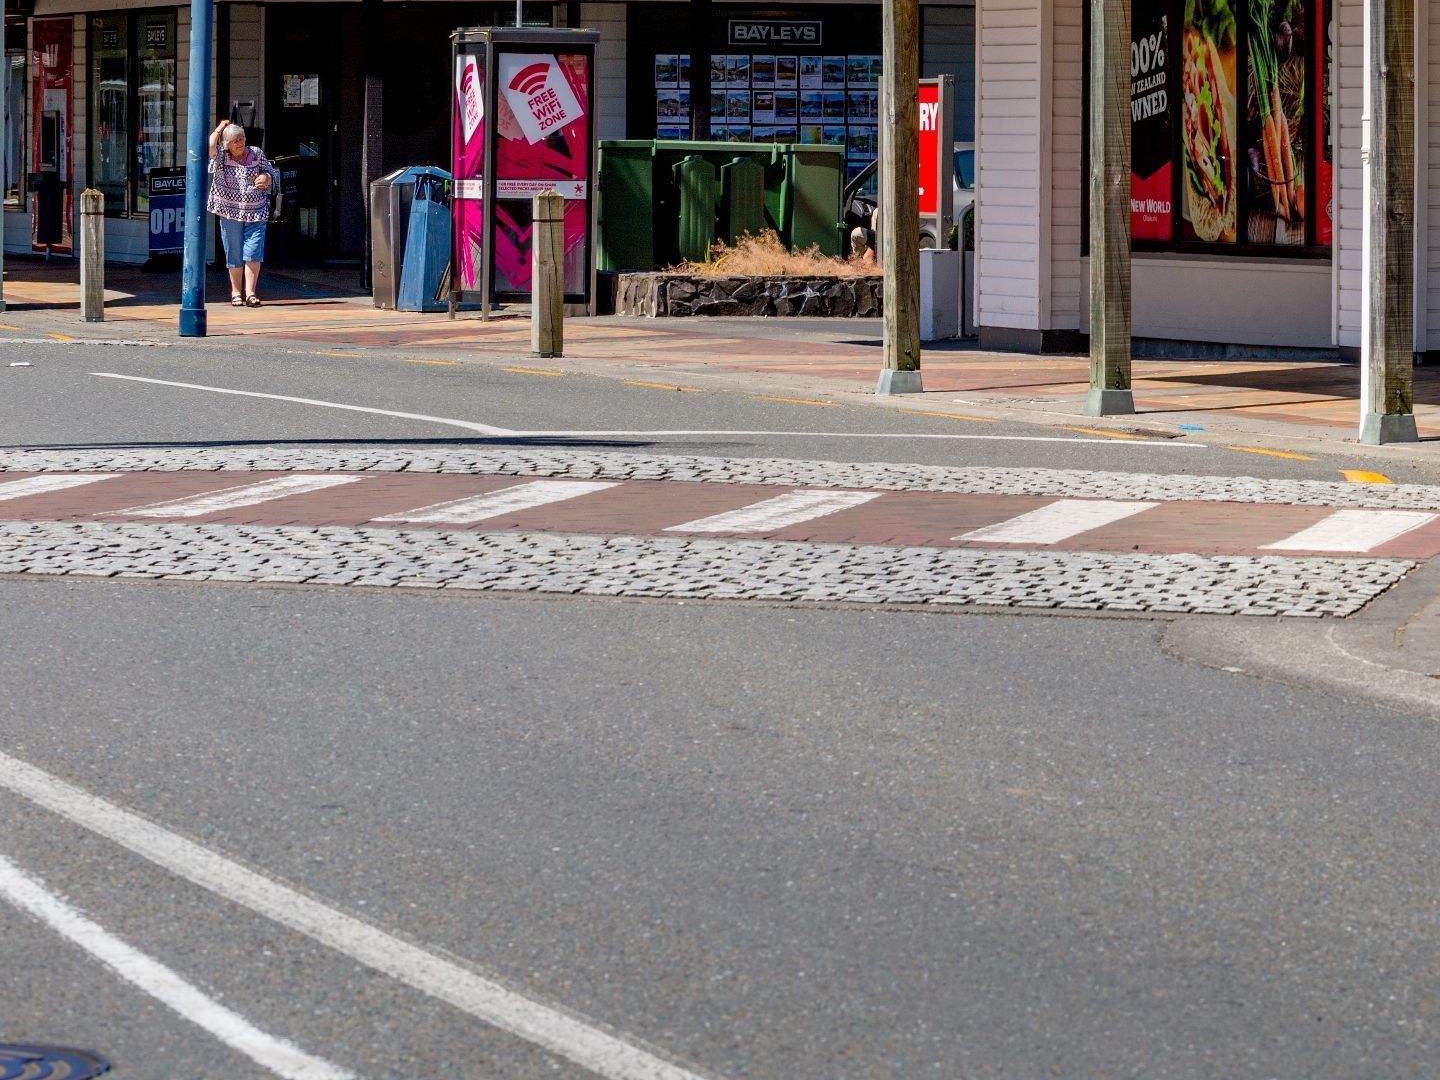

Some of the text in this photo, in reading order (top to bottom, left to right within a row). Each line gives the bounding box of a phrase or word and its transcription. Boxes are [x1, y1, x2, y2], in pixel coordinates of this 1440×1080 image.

[734, 25, 816, 40] BAYLEYS
[1131, 31, 1166, 78] 00%
[1137, 72, 1166, 91] ZEALAND
[465, 89, 476, 108] FREE
[527, 88, 557, 110] FREE
[532, 98, 562, 121] WiFi
[1131, 89, 1168, 123] WNED
[539, 110, 567, 131] ZONE
[920, 102, 938, 131] RY
[1146, 199, 1171, 214] WORLD
[150, 207, 184, 234] OPE
